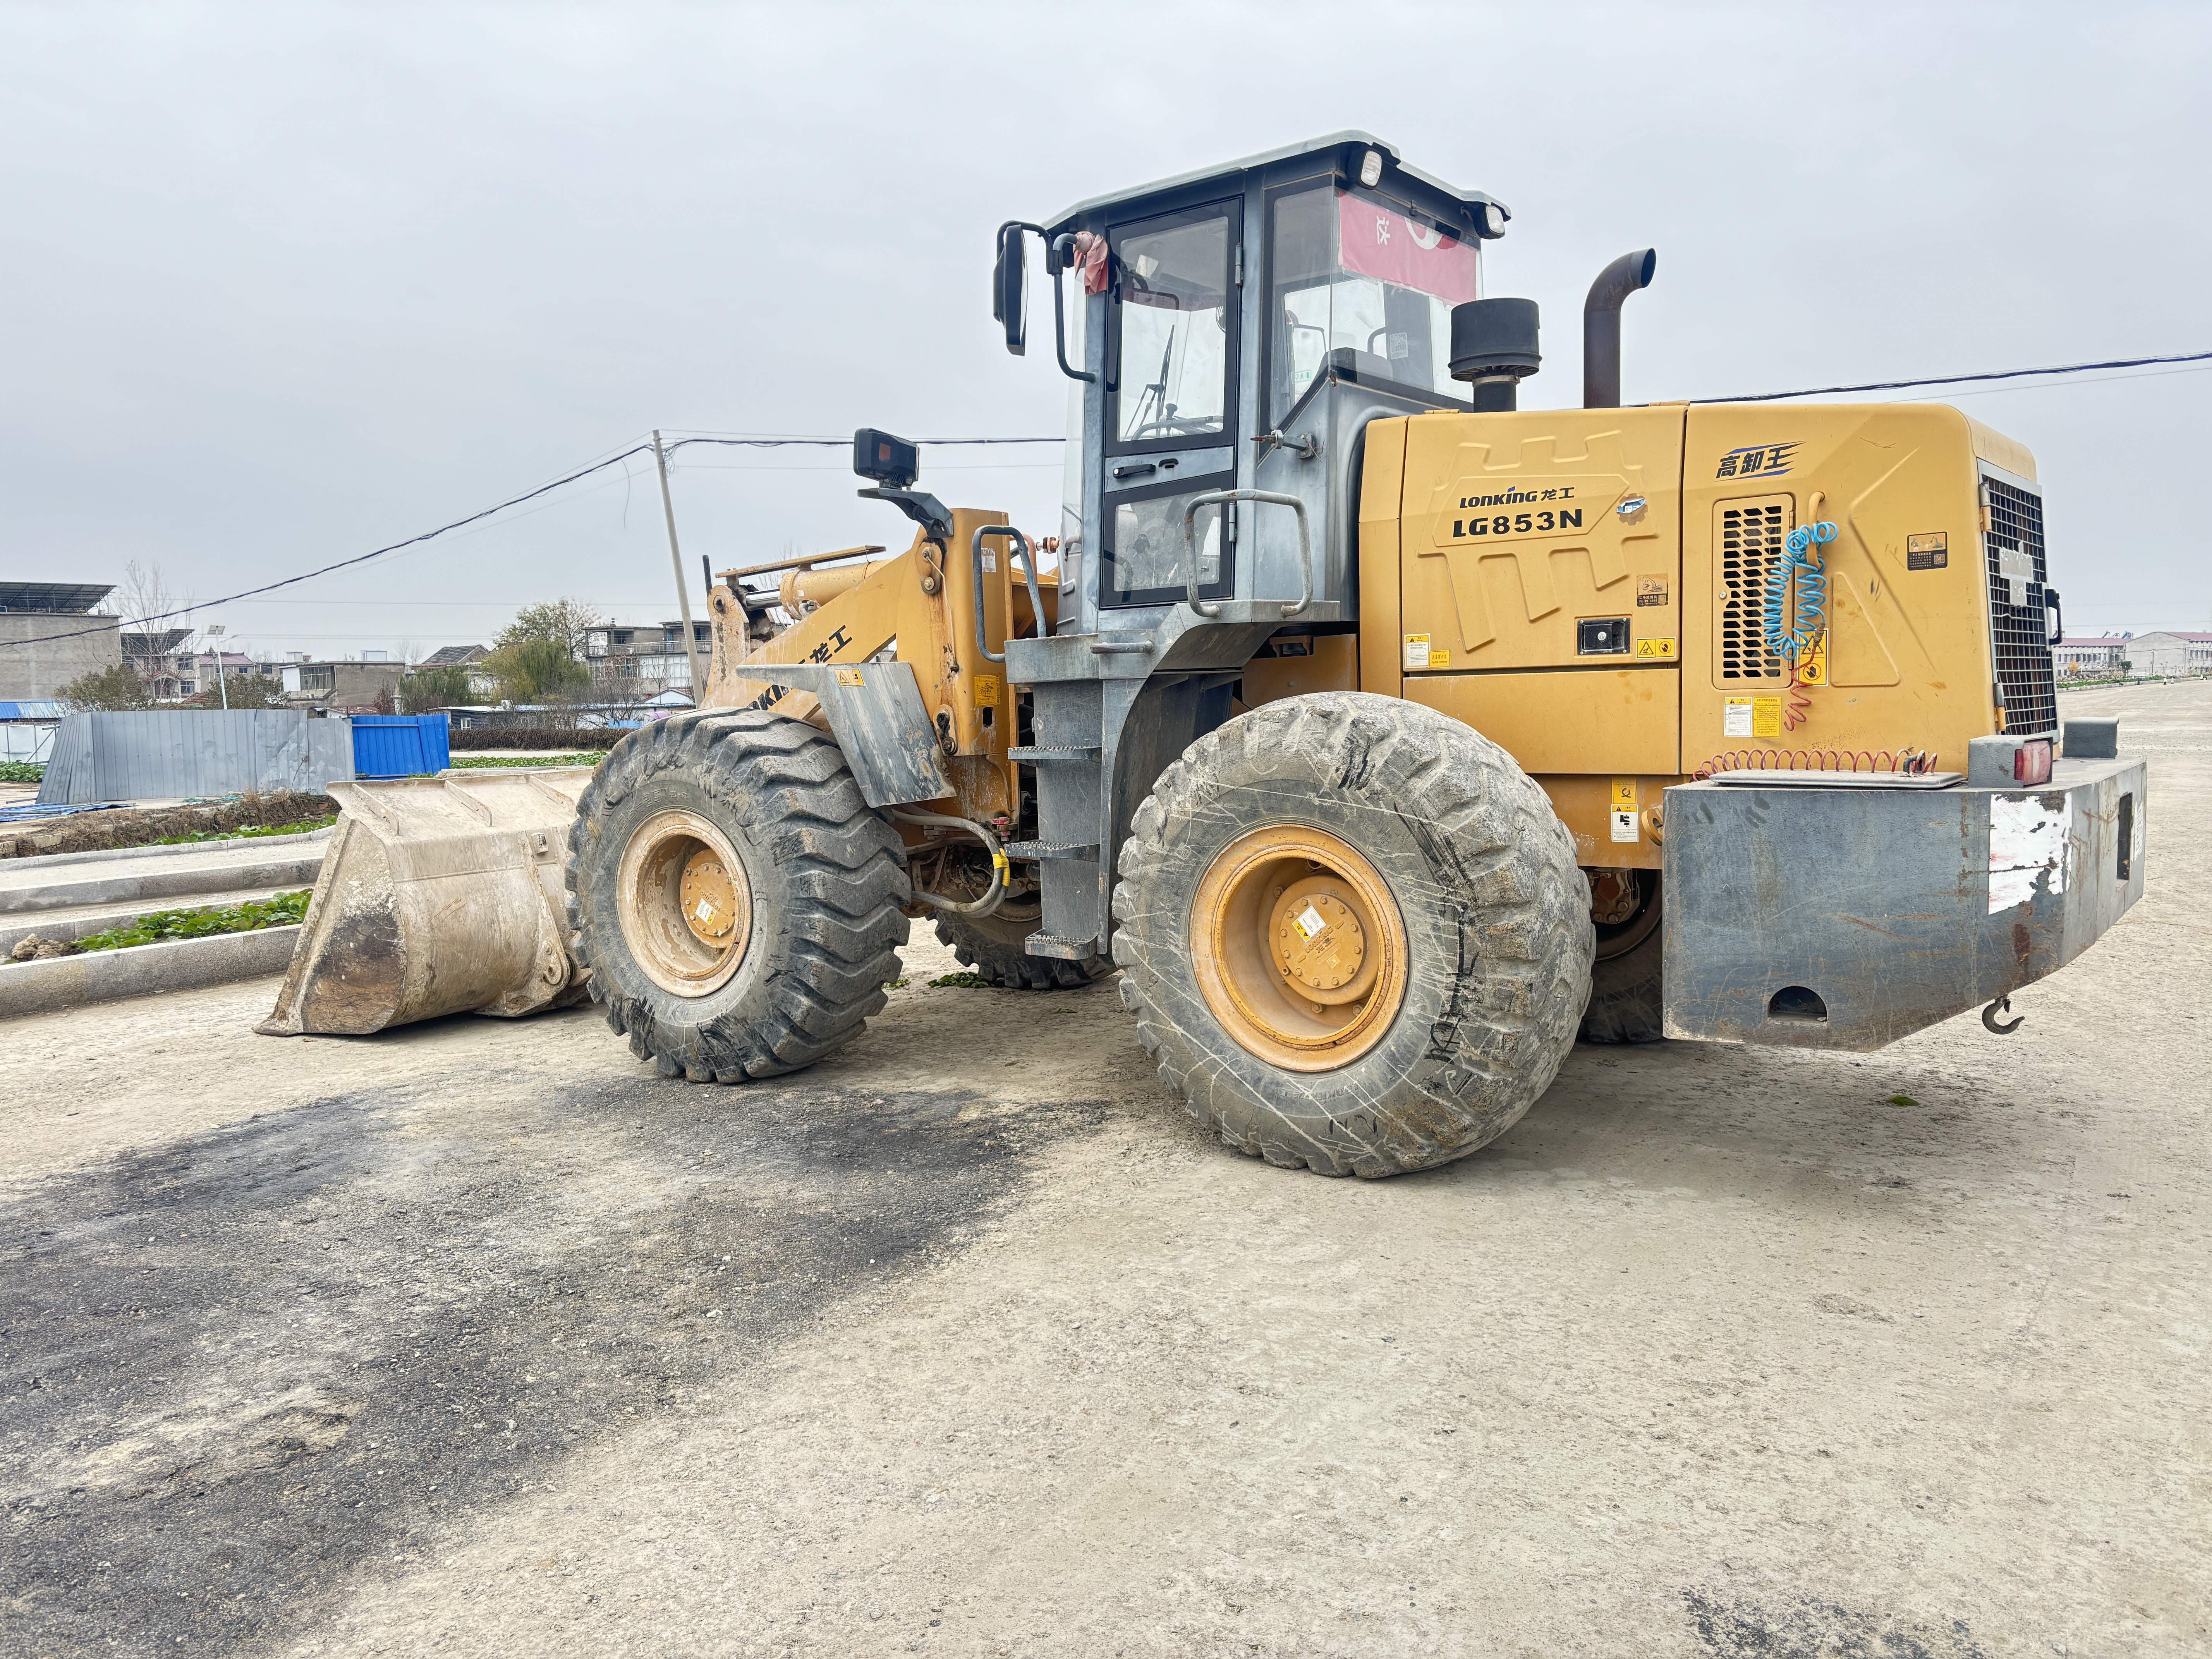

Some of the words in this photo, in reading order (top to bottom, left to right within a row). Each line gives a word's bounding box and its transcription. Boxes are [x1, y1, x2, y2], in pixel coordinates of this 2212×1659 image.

[1376, 215, 1391, 245] 达
[1716, 442, 1806, 479] 高卸王
[1540, 487, 1575, 501] 龙工
[1453, 509, 1582, 538] LG853N
[809, 625, 852, 664] 龙工
